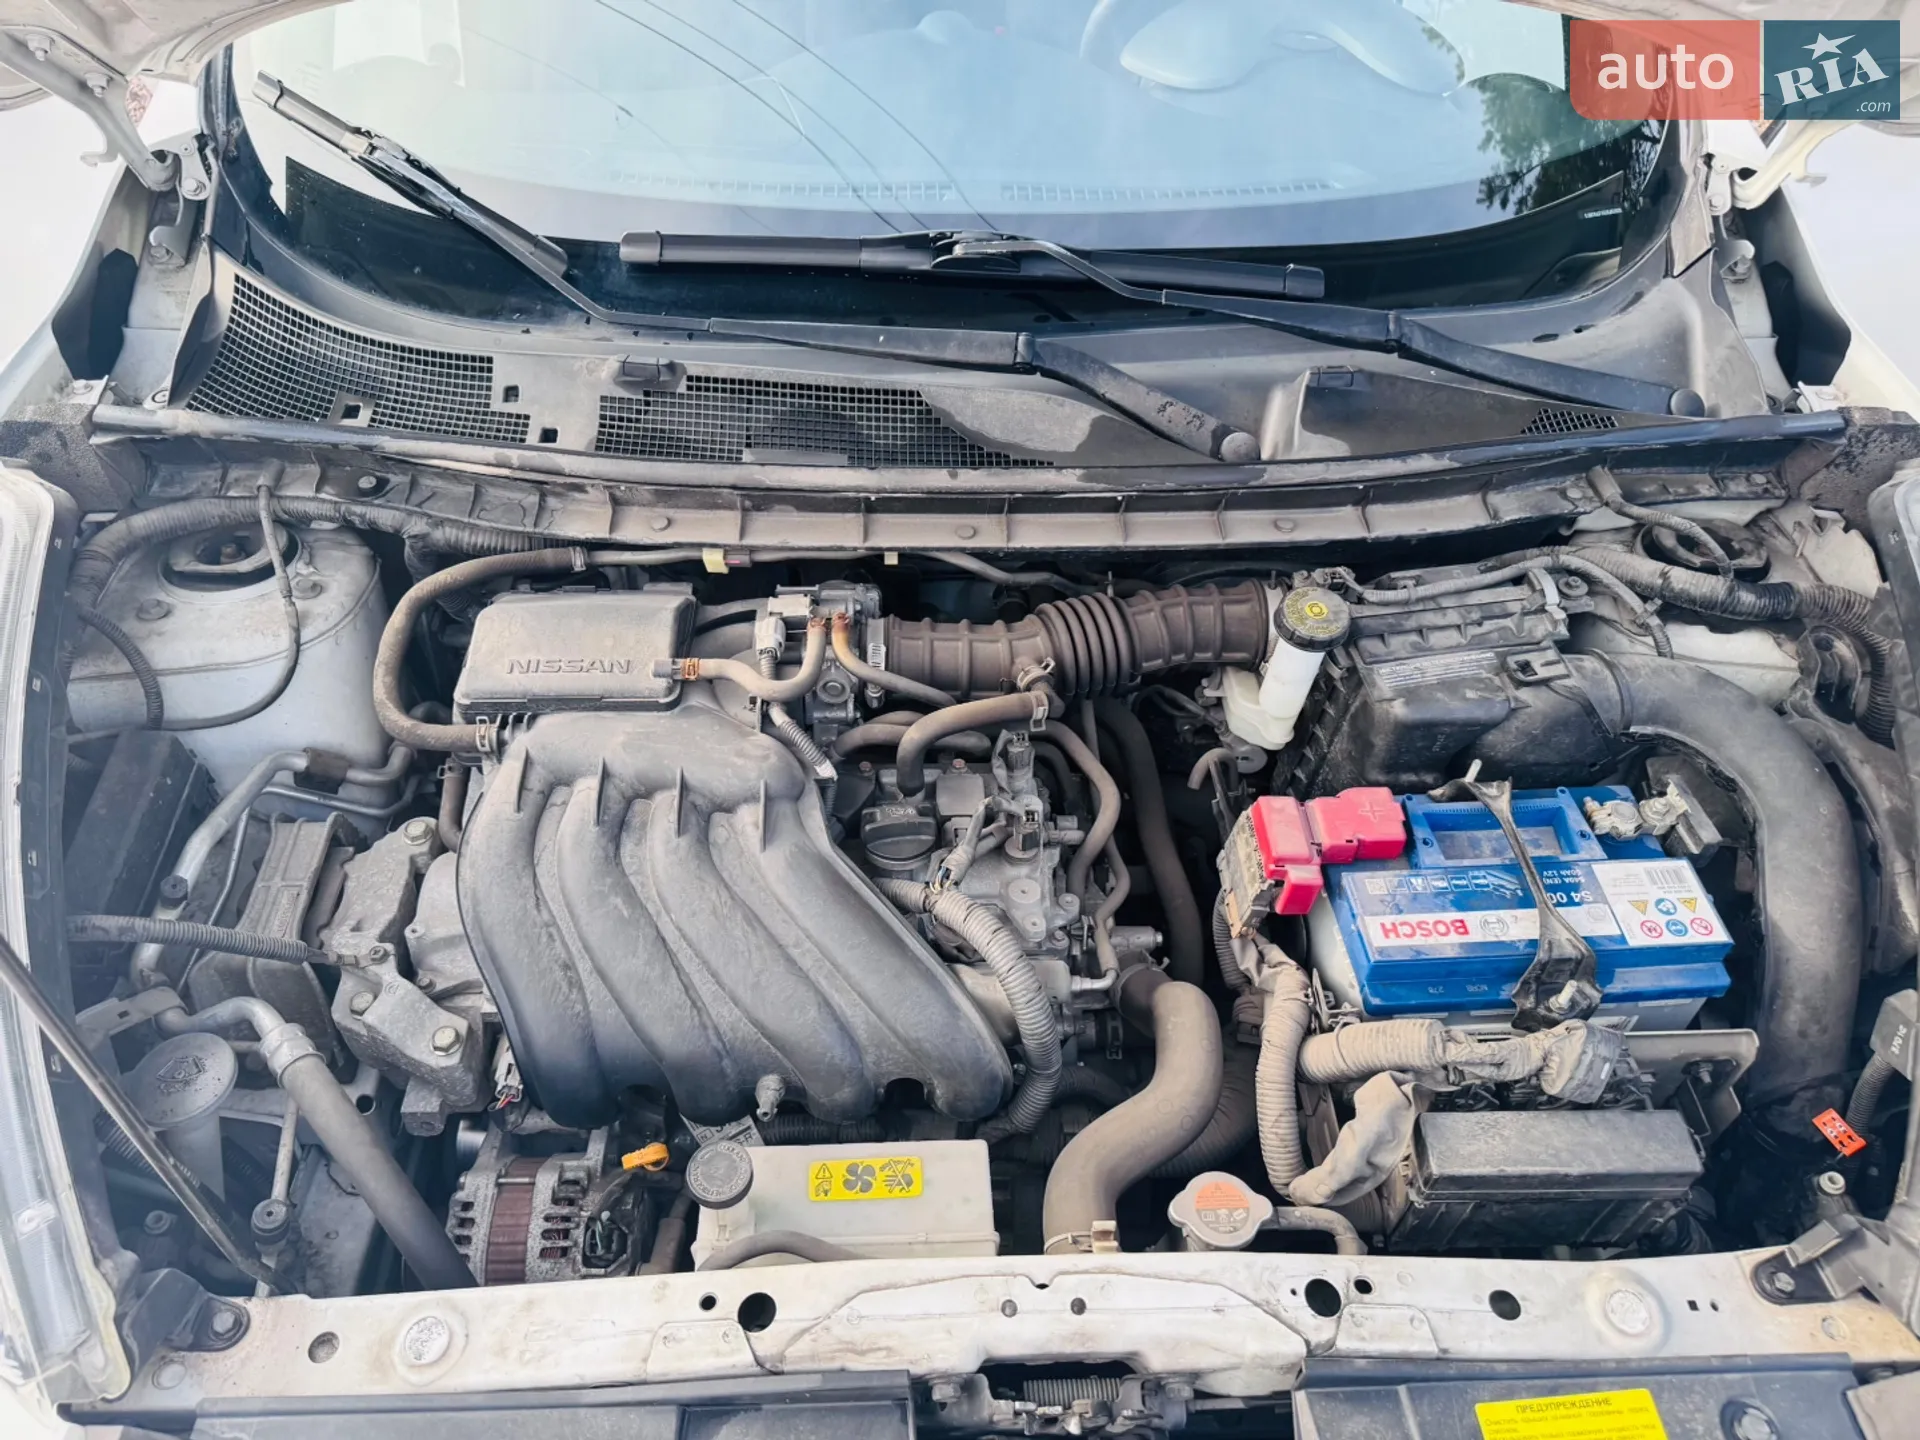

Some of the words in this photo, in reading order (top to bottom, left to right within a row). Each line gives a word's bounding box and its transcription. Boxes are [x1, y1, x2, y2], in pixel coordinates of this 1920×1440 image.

[506, 658, 632, 675] NISSAN
[1570, 890, 1593, 903] S4
[1381, 919, 1470, 939] BOSCH
[1516, 1398, 1612, 1414] ПРЕДУПРЕЖДЕНИЕ
